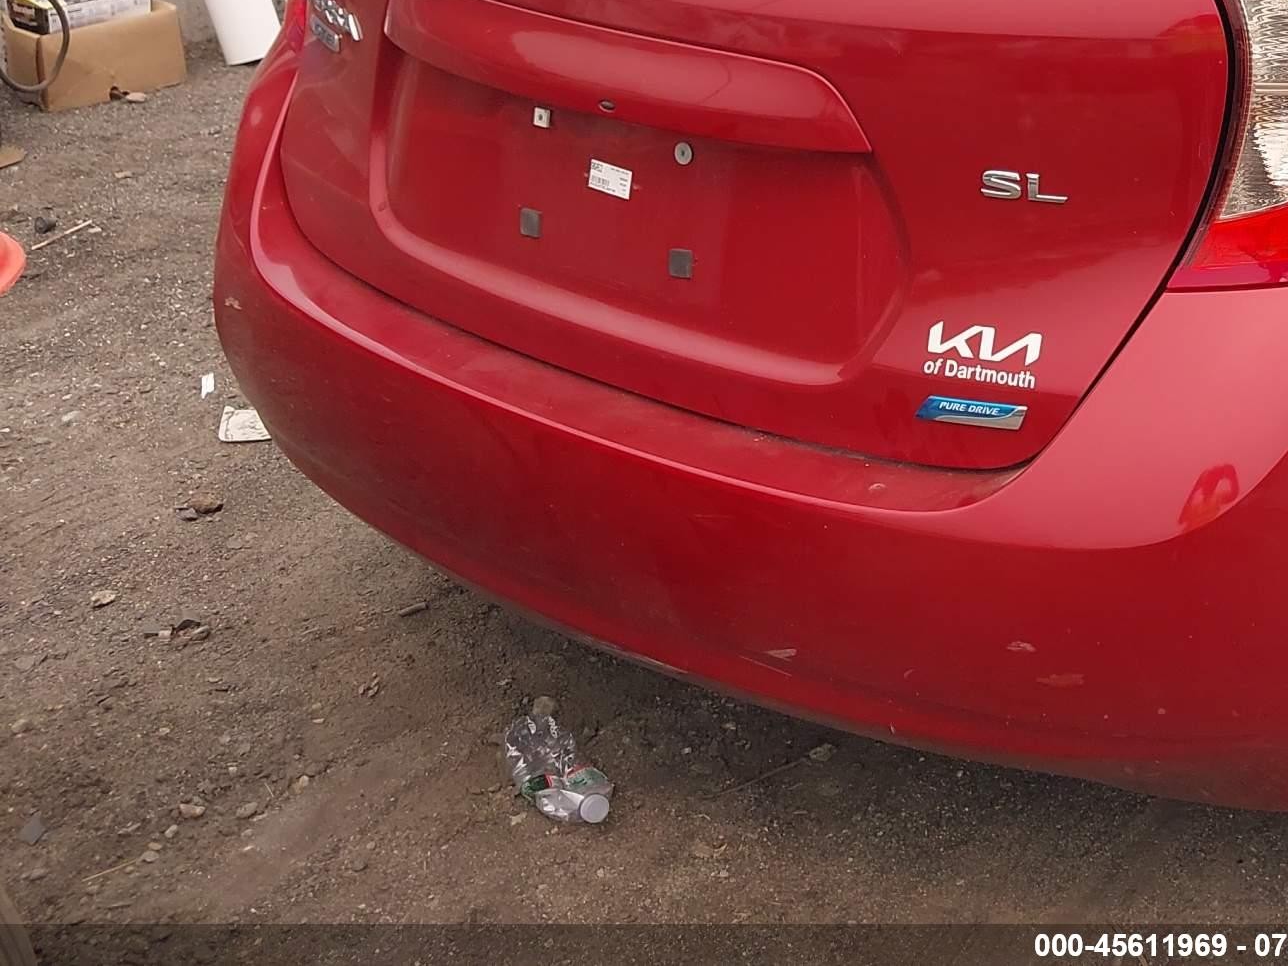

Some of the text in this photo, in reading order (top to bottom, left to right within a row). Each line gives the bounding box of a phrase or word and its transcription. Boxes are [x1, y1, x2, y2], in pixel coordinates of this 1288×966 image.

[980, 169, 1069, 204] SL
[927, 320, 1043, 367] KIA
[923, 358, 1036, 390] of Dartmouth
[938, 400, 1001, 416] PURE DRIVE
